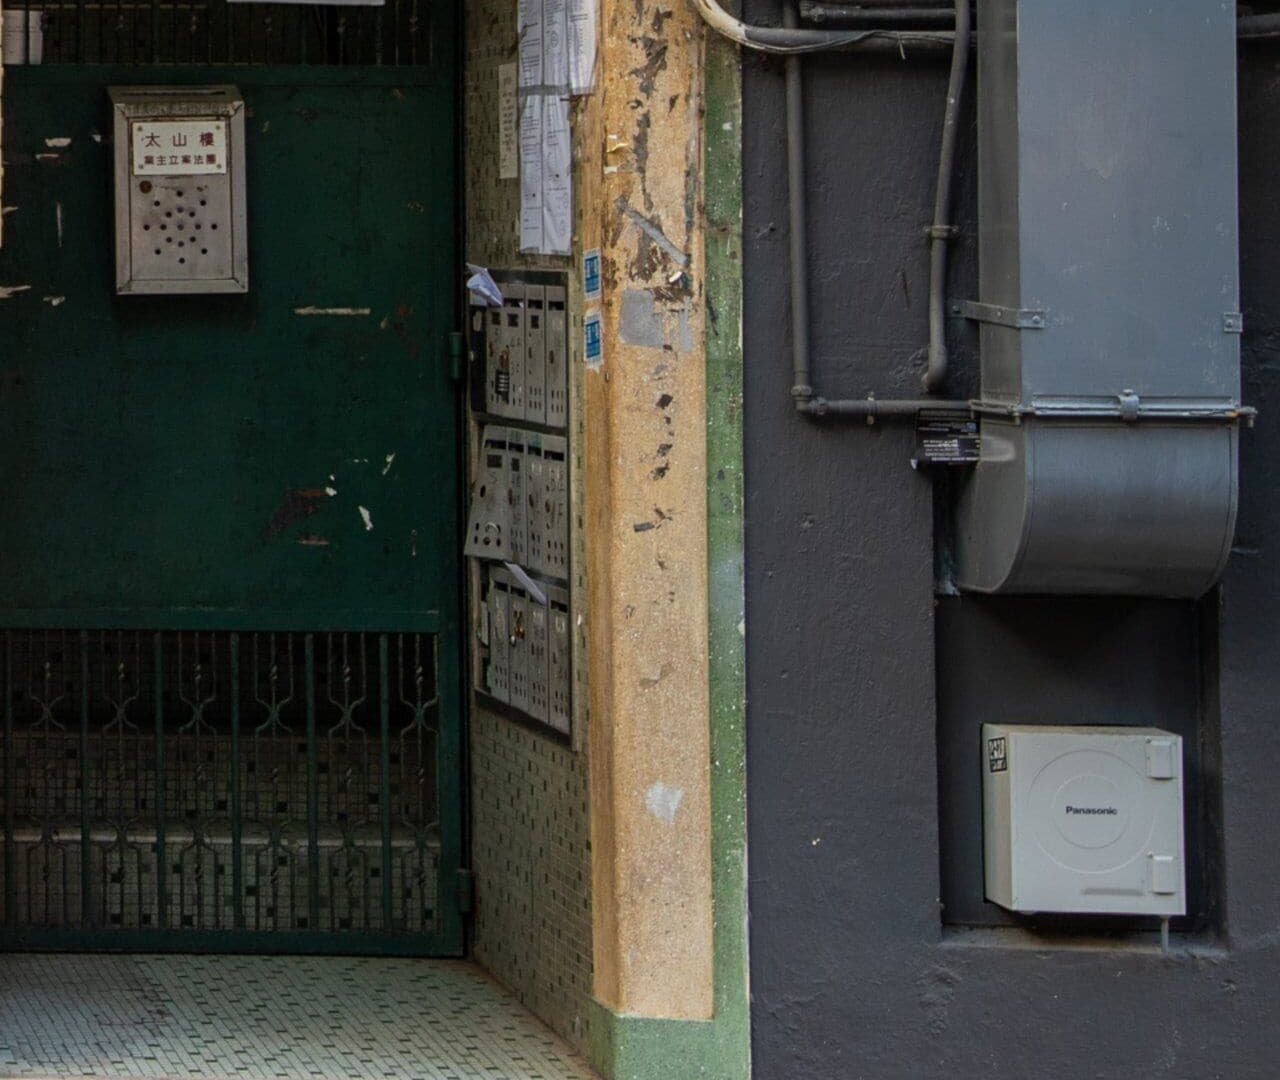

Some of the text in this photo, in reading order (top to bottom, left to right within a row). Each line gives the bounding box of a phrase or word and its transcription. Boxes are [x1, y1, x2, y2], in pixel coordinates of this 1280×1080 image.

[144, 131, 216, 148] 太山樓
[144, 153, 217, 166] 業主立案法團
[1065, 805, 1119, 816] Panasonic
